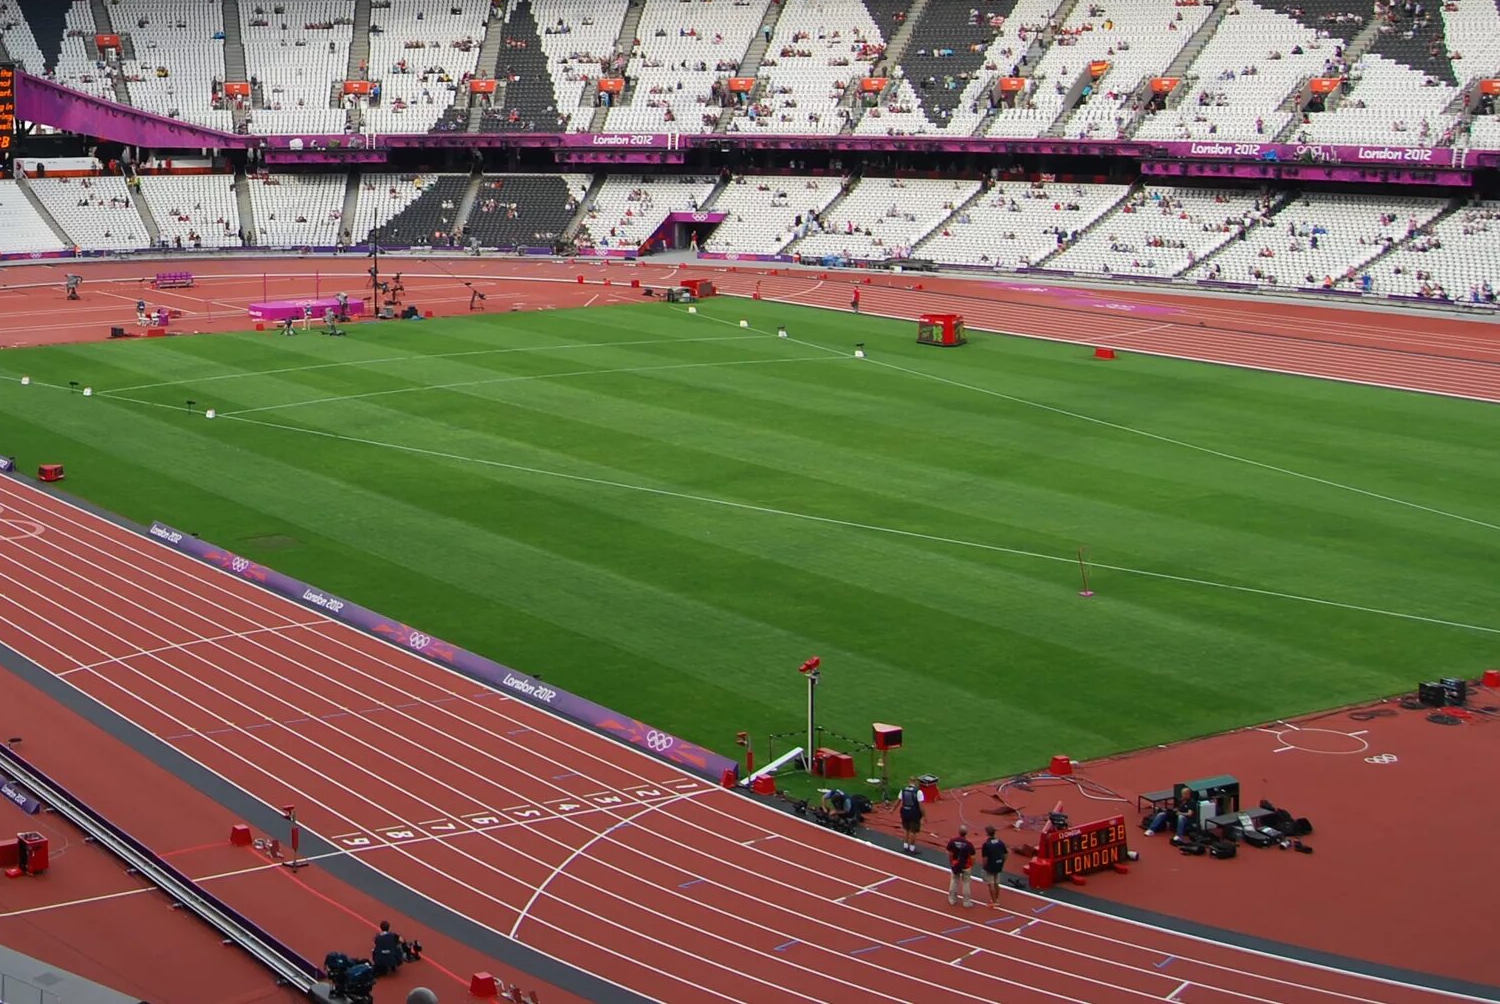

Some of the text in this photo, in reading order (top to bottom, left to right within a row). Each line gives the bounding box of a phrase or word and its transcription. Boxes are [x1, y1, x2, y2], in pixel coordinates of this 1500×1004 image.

[593, 135, 654, 145] London 2012
[1191, 142, 1261, 156] London 2012
[1358, 147, 1433, 161] London 2012
[150, 524, 182, 544] London 2012
[303, 589, 344, 613] London 2012
[502, 673, 557, 703] London 2012
[675, 782, 698, 791] 1
[635, 788, 661, 799] 2
[593, 795, 623, 805] 3
[558, 802, 581, 813] 4
[513, 809, 542, 819] 5
[471, 815, 500, 826] 6
[431, 822, 457, 833] 7
[385, 830, 415, 841] 8
[343, 837, 371, 847] 9
[1065, 847, 1119, 875] LONDON
